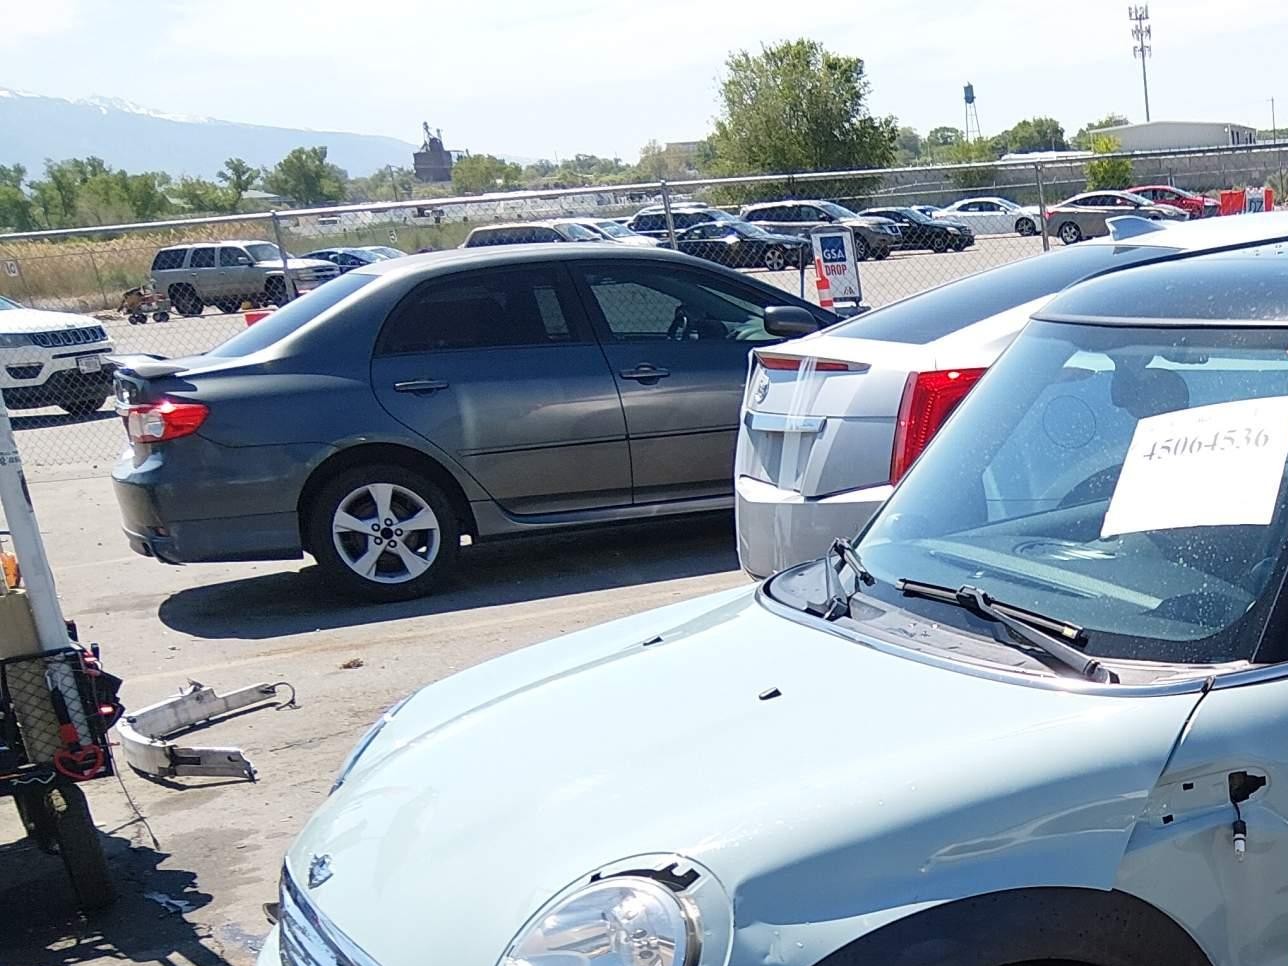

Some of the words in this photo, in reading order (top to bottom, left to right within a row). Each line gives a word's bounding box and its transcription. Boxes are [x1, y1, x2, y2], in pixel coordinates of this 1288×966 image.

[823, 249, 845, 260] GSA
[824, 264, 847, 276] DROP
[1143, 427, 1269, 460] 45064536
